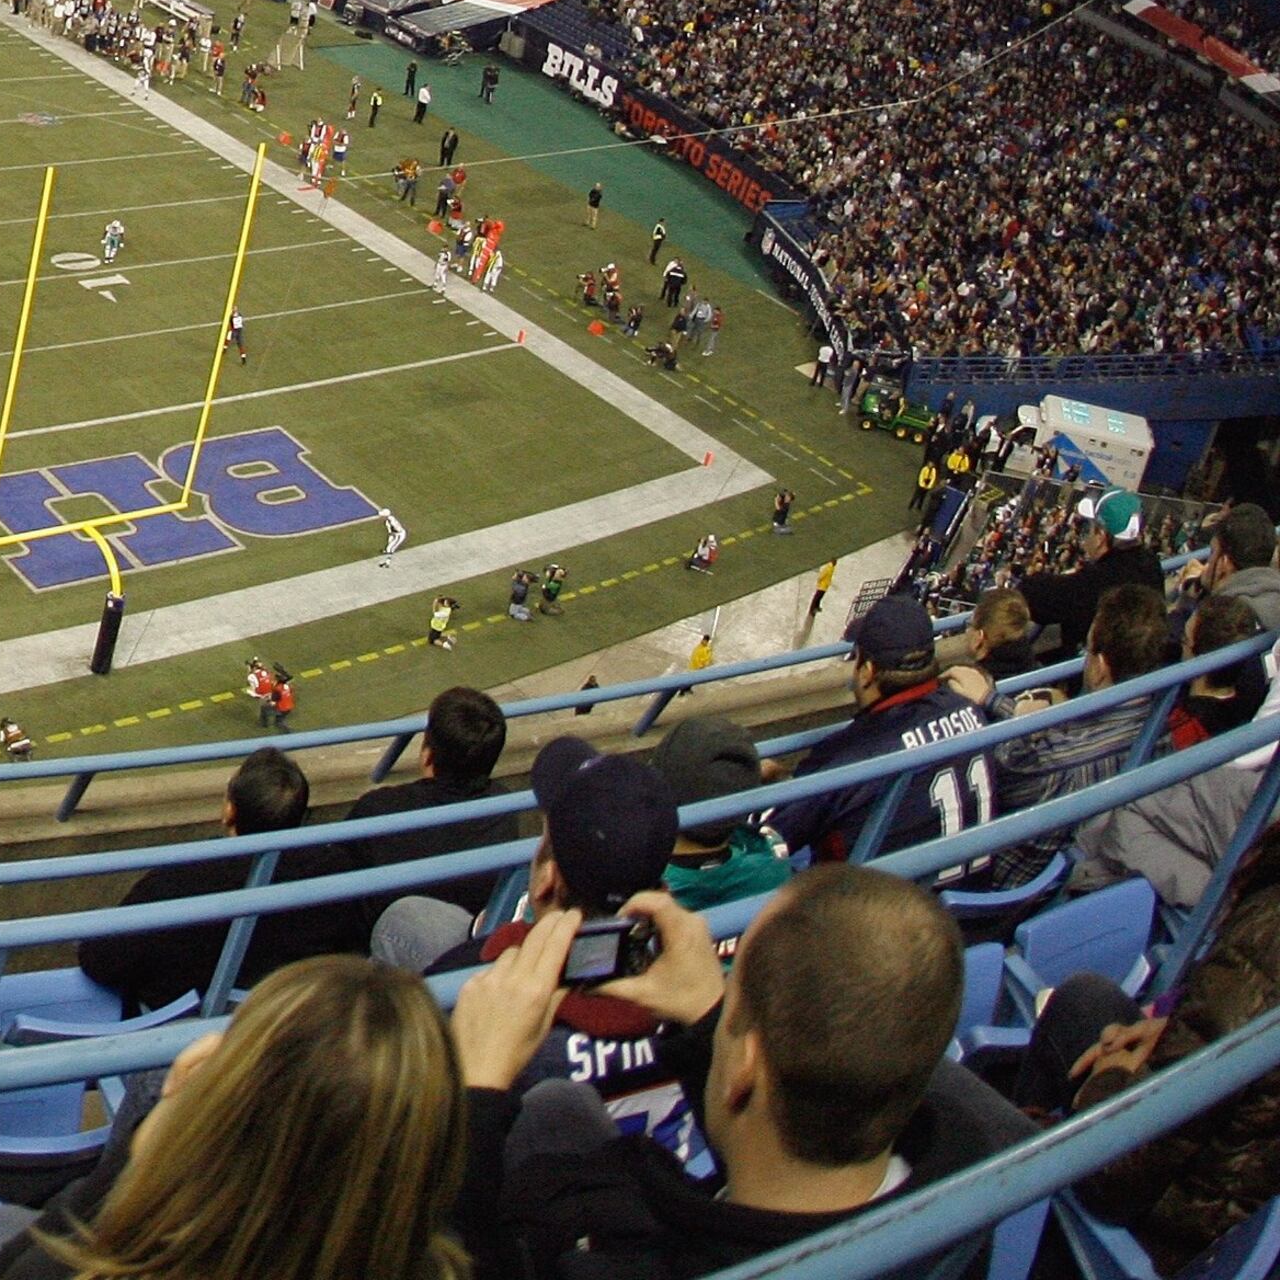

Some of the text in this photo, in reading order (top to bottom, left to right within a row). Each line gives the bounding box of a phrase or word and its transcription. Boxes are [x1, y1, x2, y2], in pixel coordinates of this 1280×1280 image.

[542, 42, 618, 108] BILLS
[704, 153, 773, 215] SERIES
[51, 252, 131, 290] 10
[772, 242, 809, 291] NATIONAL
[901, 706, 984, 751] BLEDSOE
[929, 754, 993, 886] 11
